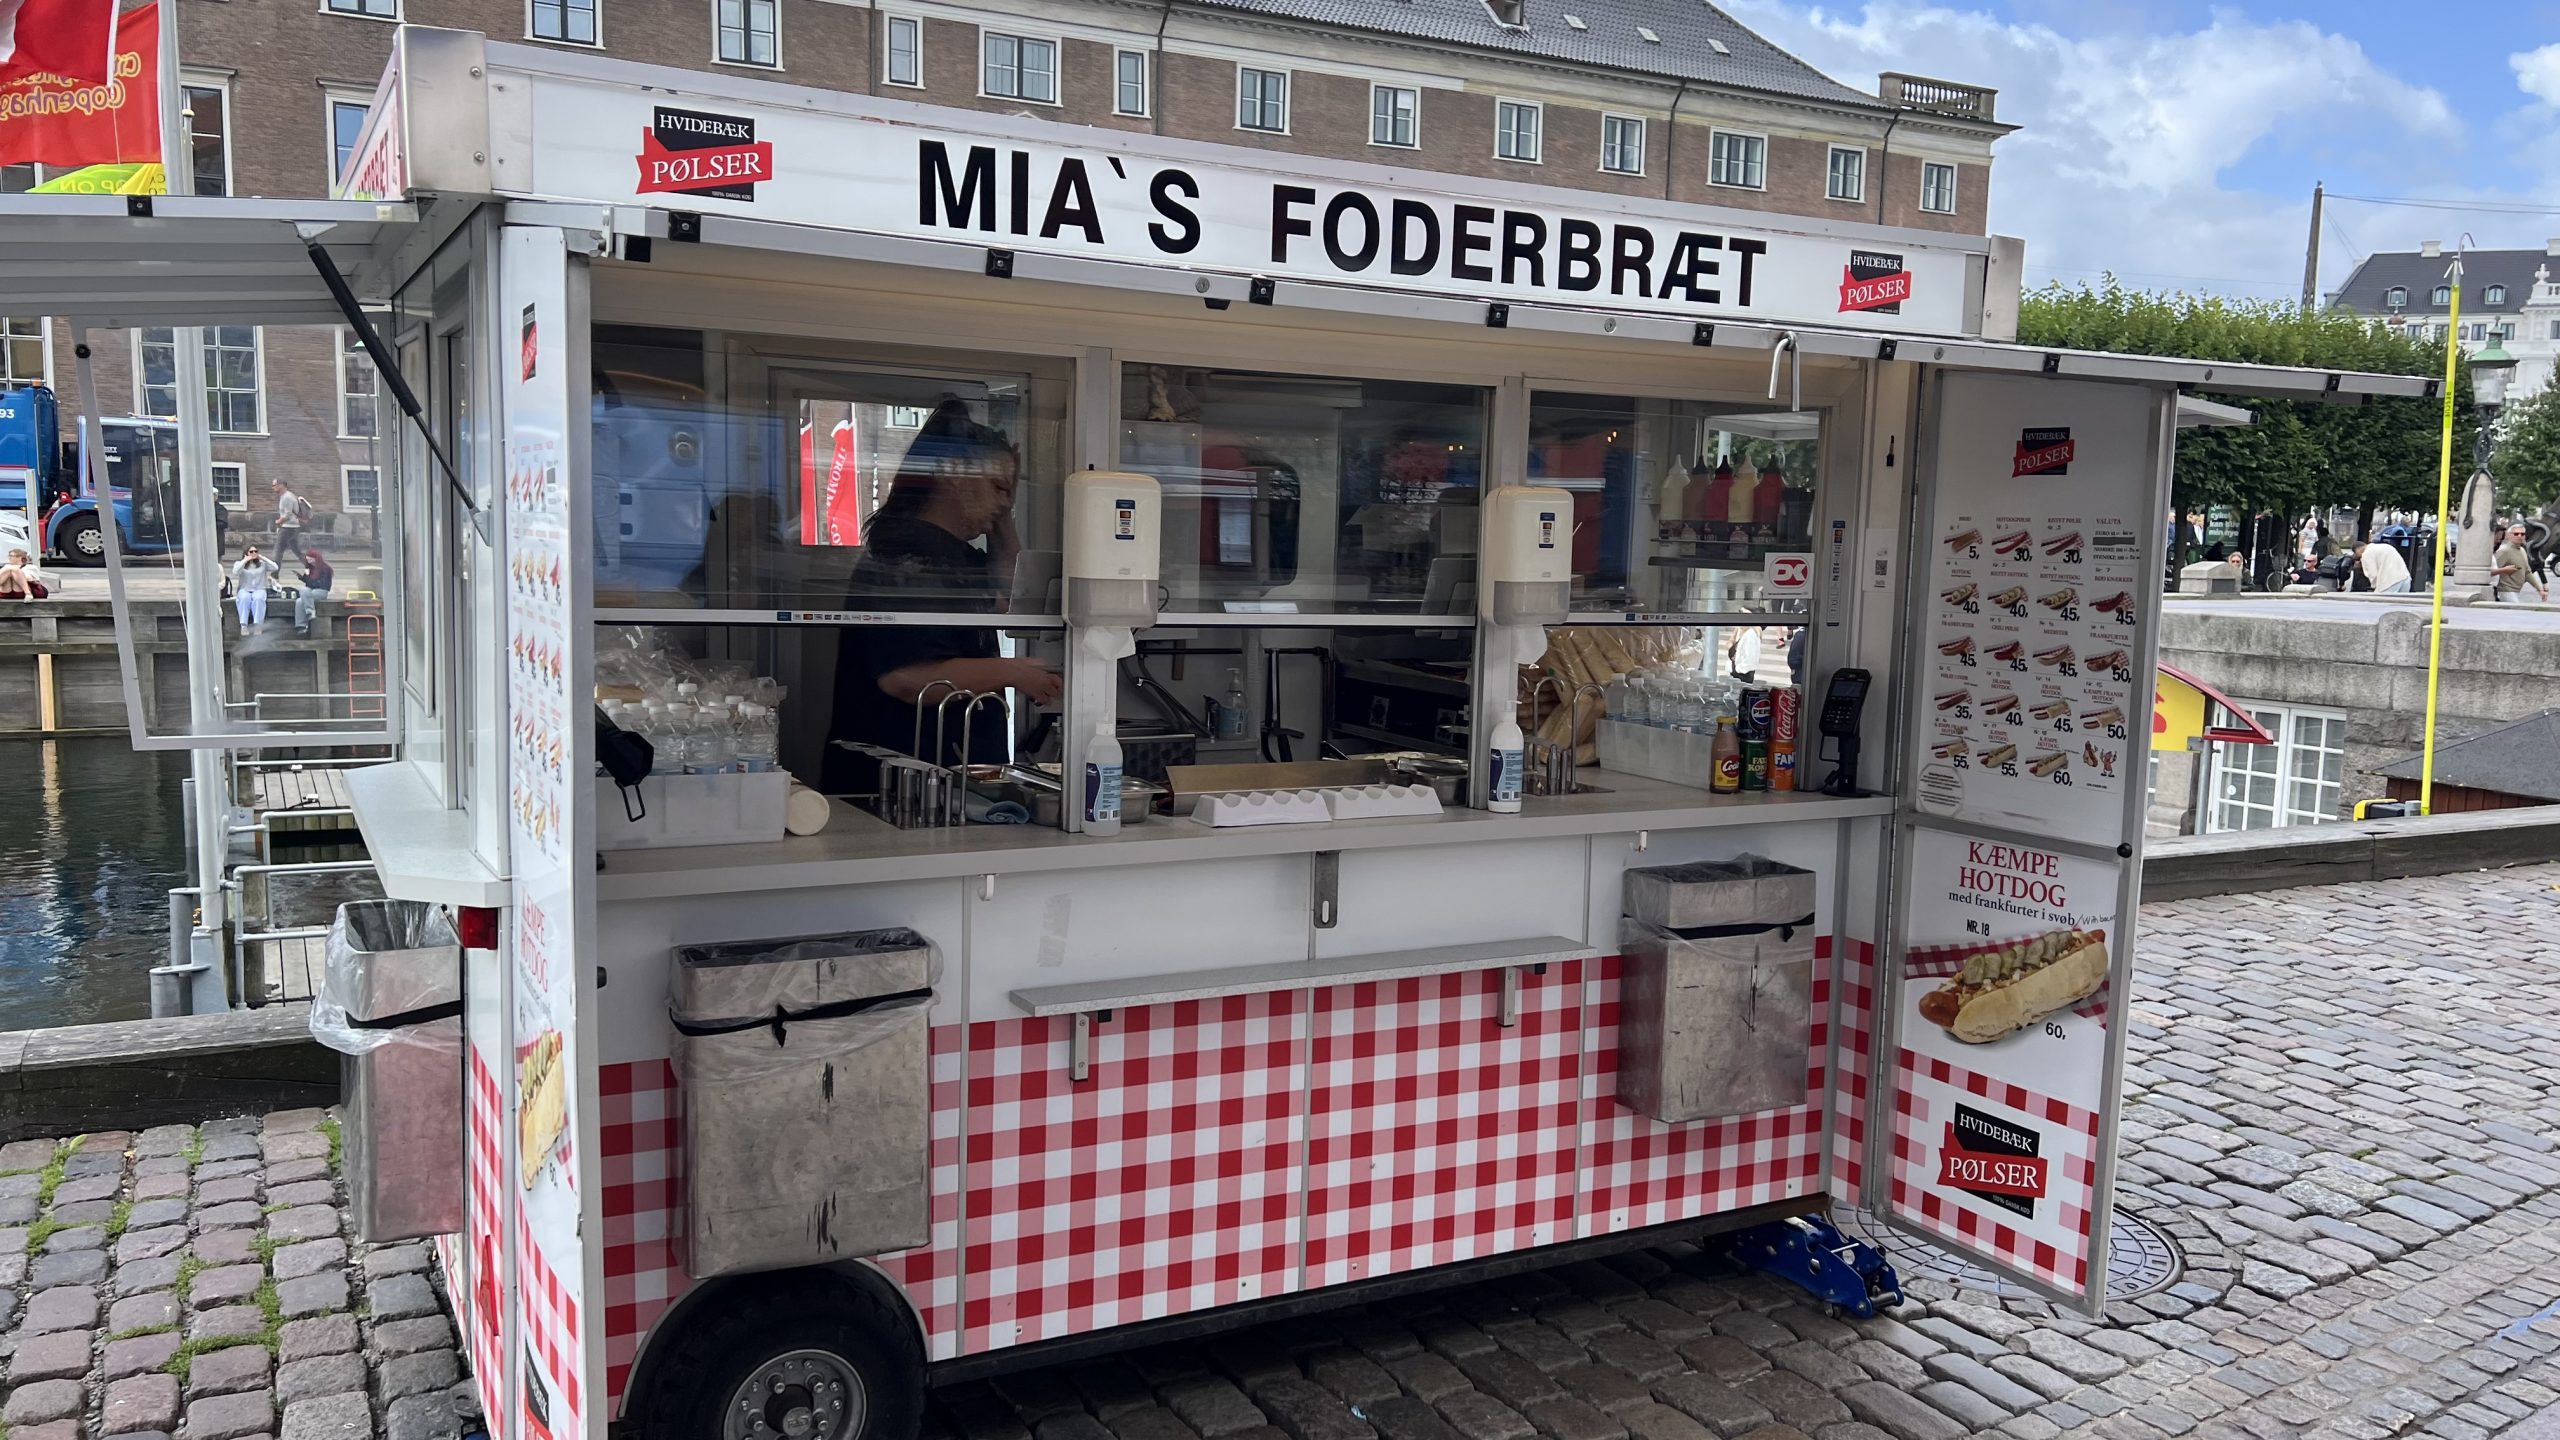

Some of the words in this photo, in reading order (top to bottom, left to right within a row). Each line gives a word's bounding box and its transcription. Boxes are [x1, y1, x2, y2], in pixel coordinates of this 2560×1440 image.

[659, 113, 750, 139] HVIDEBÆK
[652, 151, 763, 185] PØLSER
[1270, 183, 1767, 308] FODERBRÆT
[1847, 279, 1905, 306] PØLSER
[1962, 601, 1980, 615] 40,
[2009, 604, 2029, 618] 40,
[2060, 607, 2080, 622] 45,
[2115, 611, 2136, 626] 45,
[1959, 653, 1977, 668] 45,
[2010, 658, 2029, 673] 45,
[2058, 661, 2079, 678] 45,
[2112, 667, 2133, 684] 50,
[1954, 704, 1973, 720] 35,
[2005, 712, 2024, 727] 40,
[2053, 717, 2074, 733] 45,
[2107, 723, 2127, 741] 50,
[1953, 754, 1970, 770] 55,
[2001, 762, 2019, 778] 55,
[2053, 770, 2073, 787] 60,
[1968, 841, 2060, 878] KÆMPE
[1959, 866, 2067, 908] HOTDOG
[1949, 891, 1972, 905] med
[1975, 894, 2039, 919] frankfurter
[2041, 908, 2046, 920] i
[2048, 911, 2076, 927] svøb
[1981, 922, 1991, 937] 18
[2045, 1021, 2068, 1041] 60,
[1959, 1113, 2033, 1153] HVIDEBÆK
[1948, 1156, 2039, 1189] PØLSER
